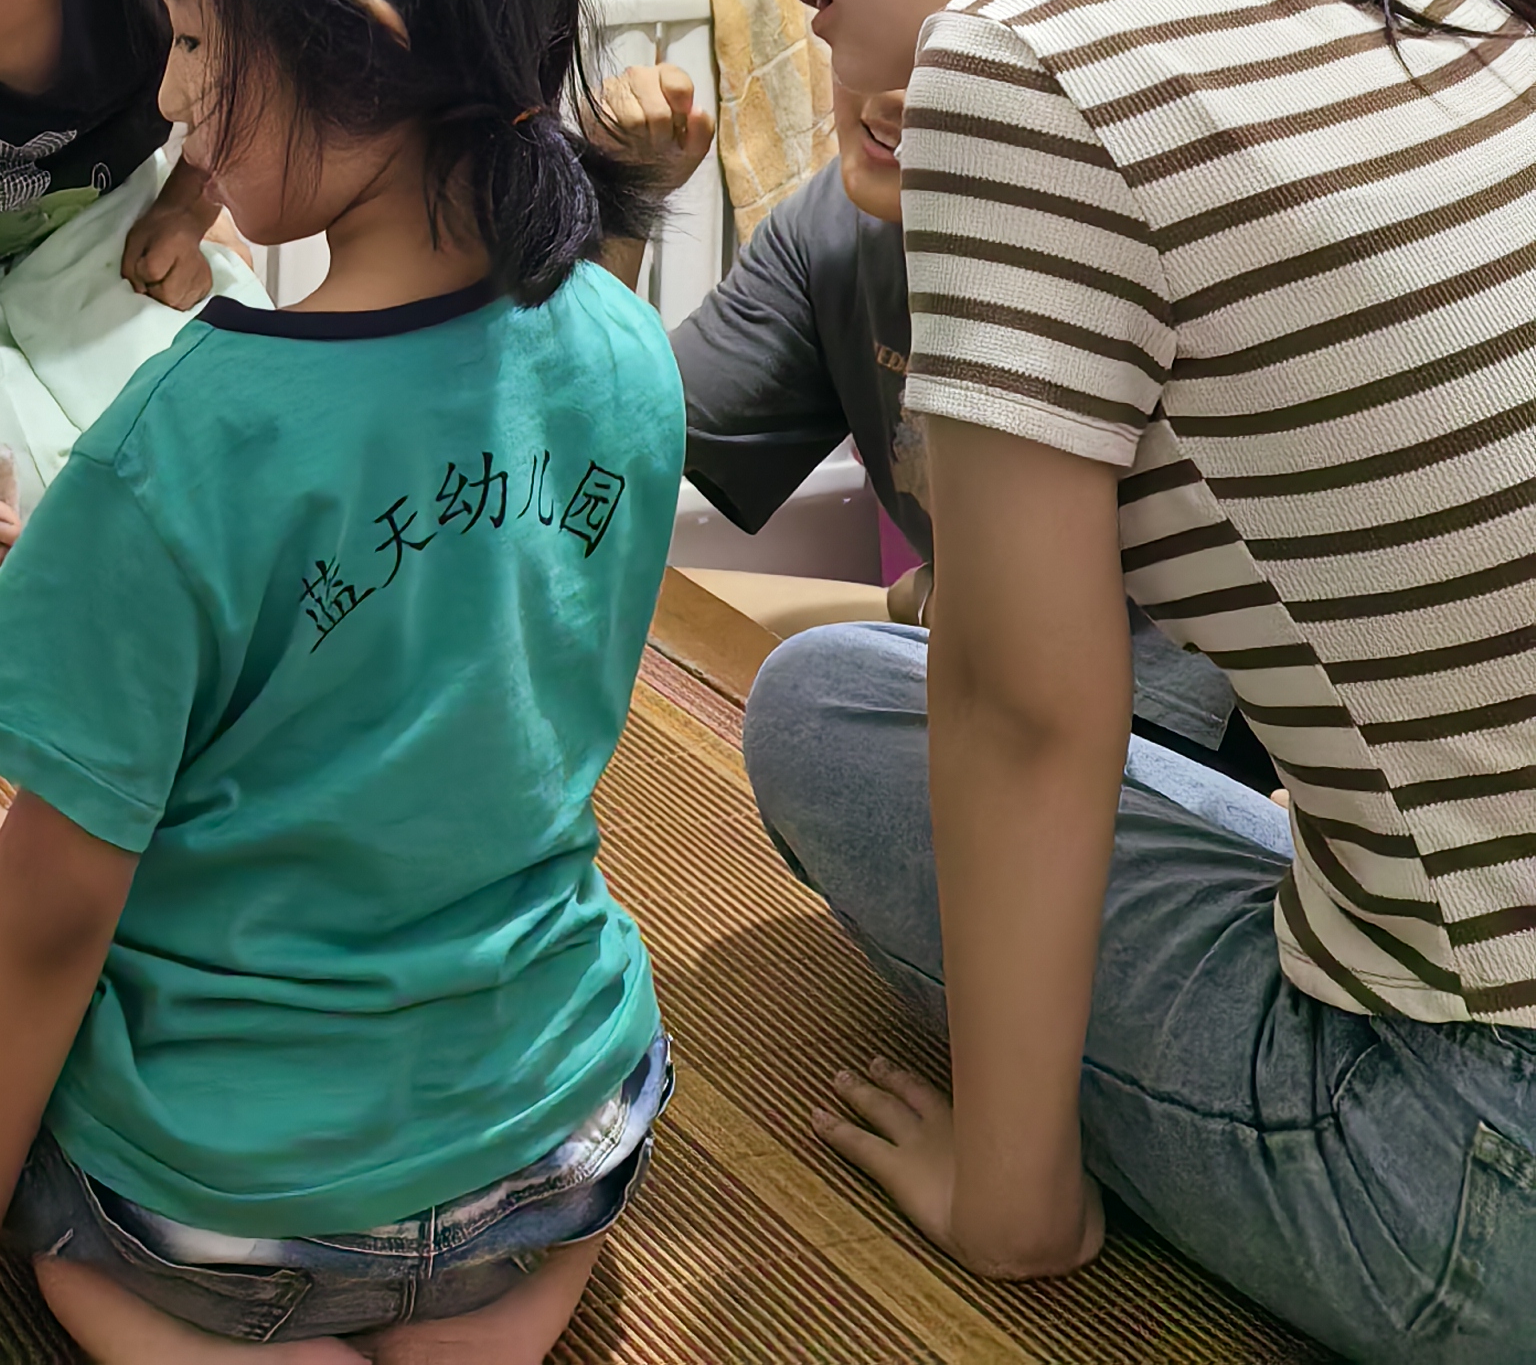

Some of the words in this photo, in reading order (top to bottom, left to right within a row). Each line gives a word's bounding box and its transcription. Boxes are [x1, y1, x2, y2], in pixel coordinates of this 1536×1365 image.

[299, 449, 626, 655] 蓝天幼儿园
